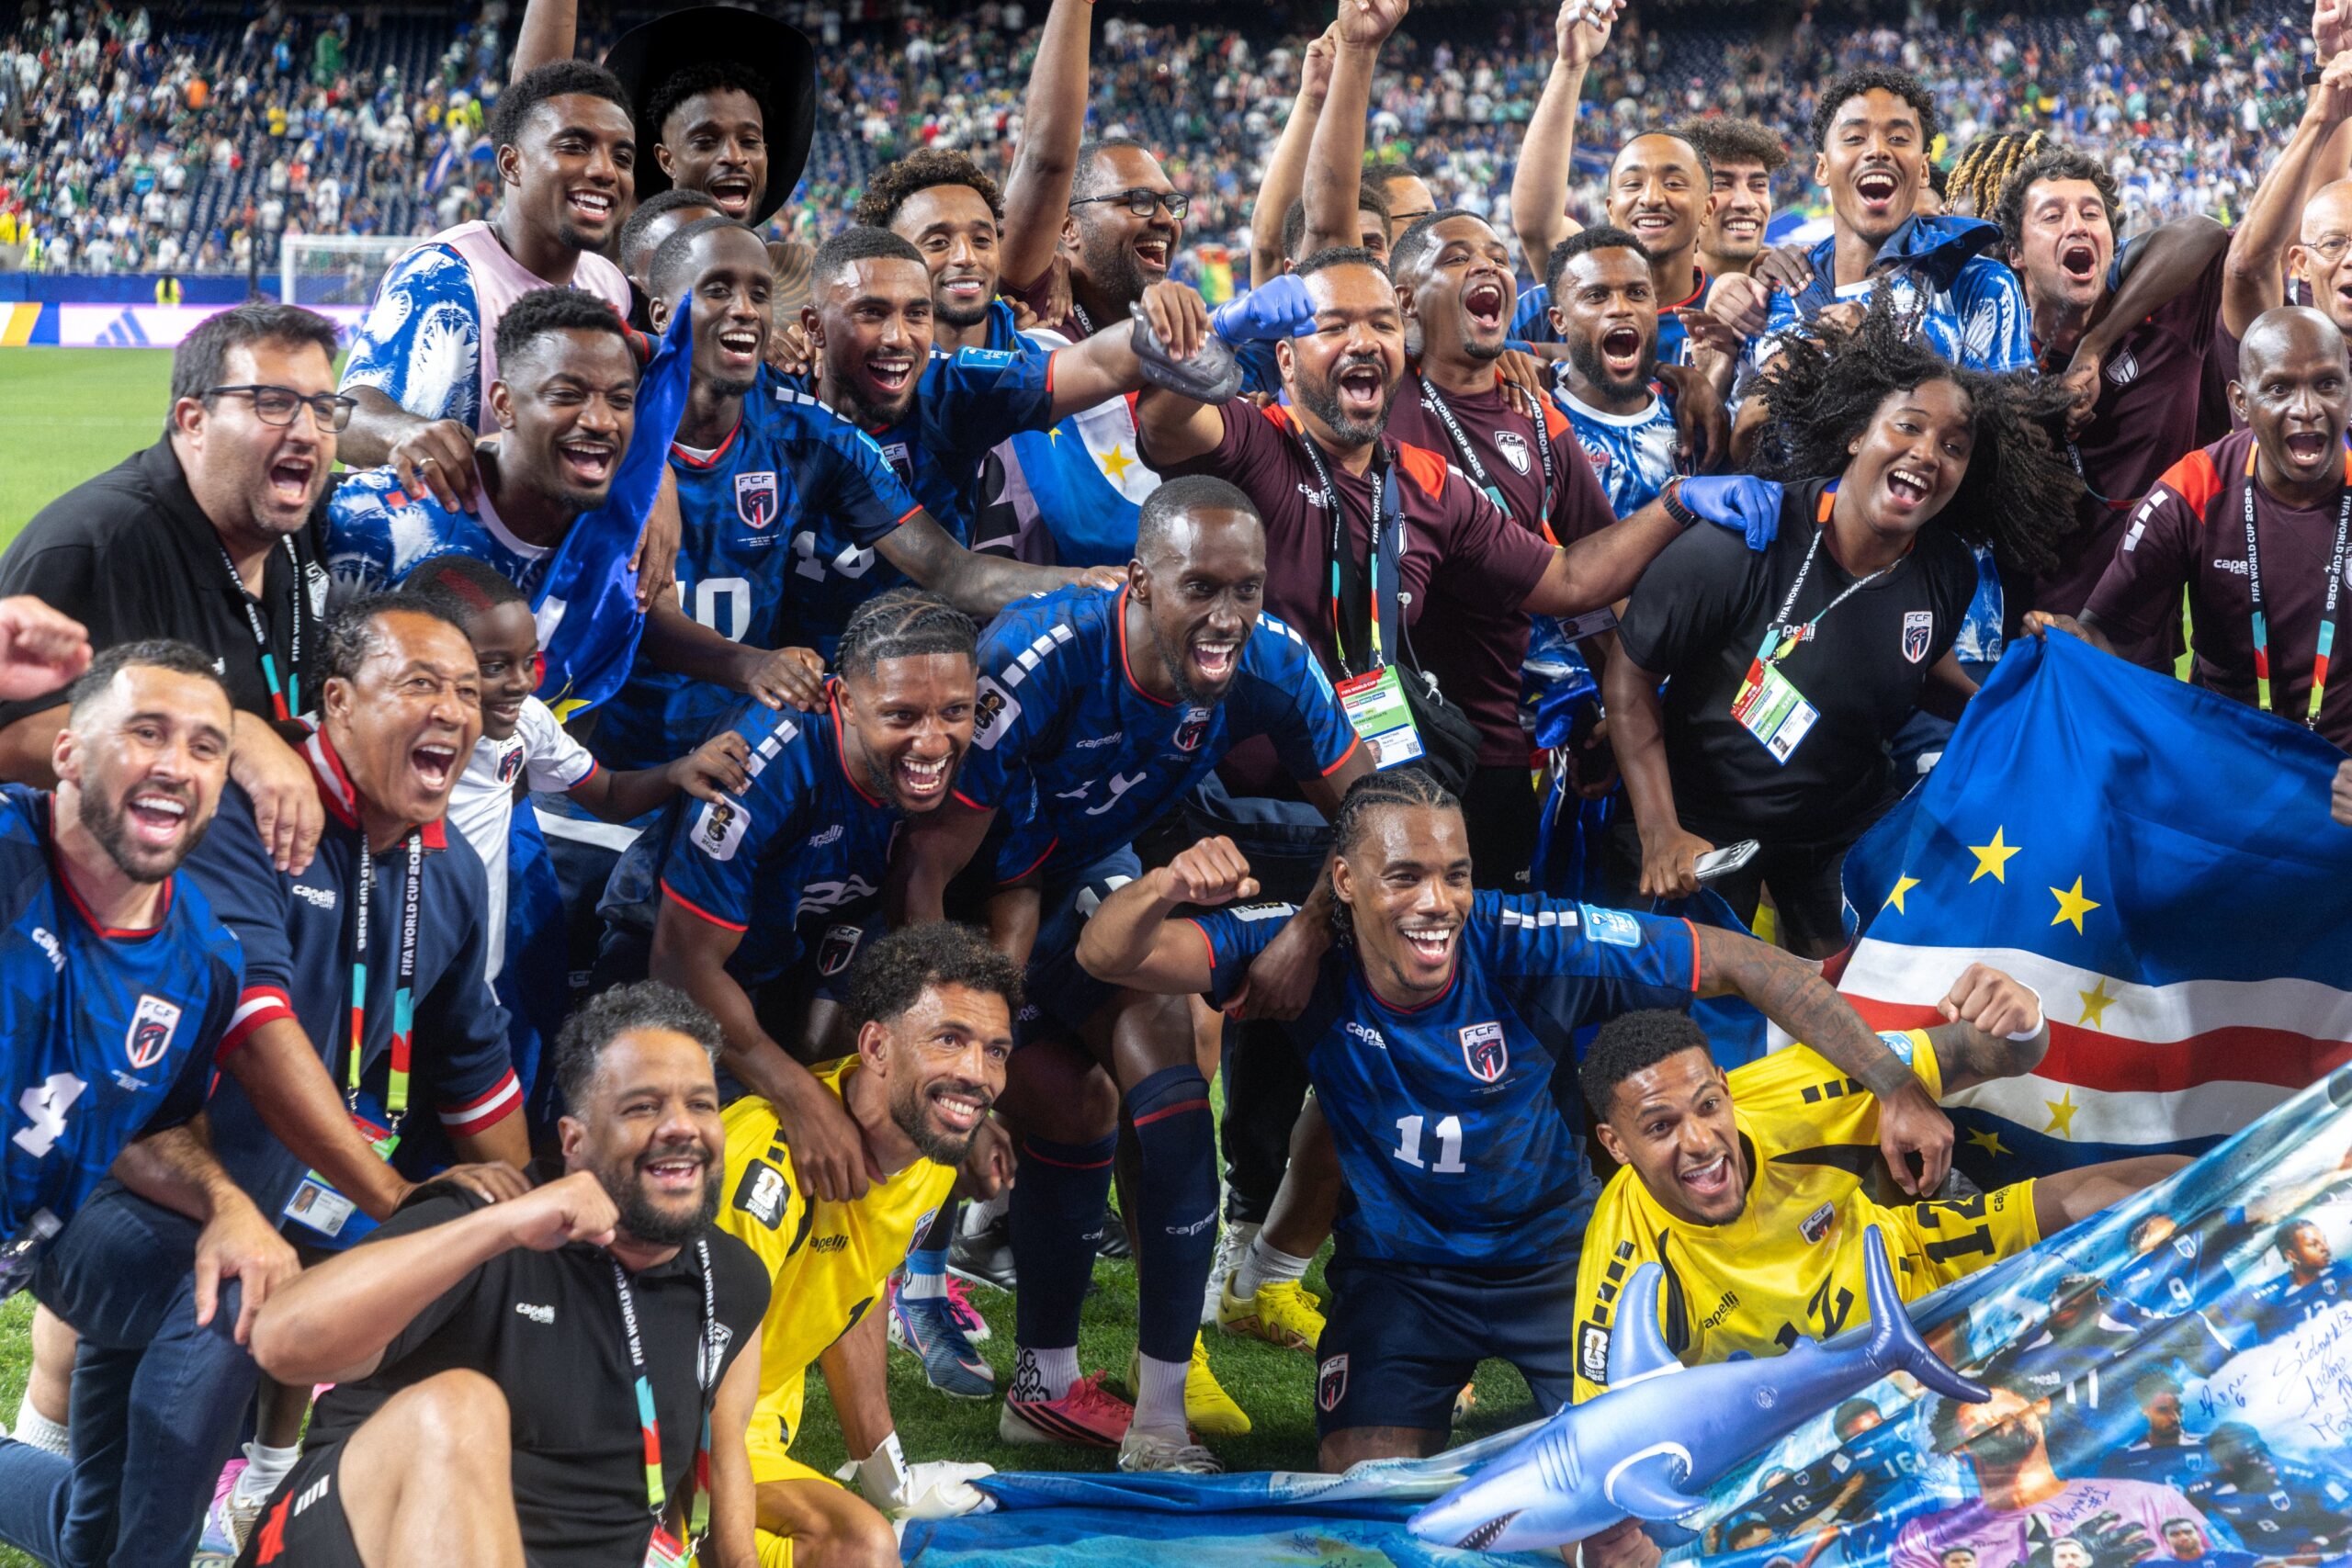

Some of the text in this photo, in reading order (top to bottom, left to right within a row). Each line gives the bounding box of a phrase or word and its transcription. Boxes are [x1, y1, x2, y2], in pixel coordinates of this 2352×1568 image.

[1074, 303, 1093, 333] 2026
[1422, 381, 1436, 400] FIFA
[1433, 397, 1456, 429] WORLD
[1453, 426, 1467, 447] CUP
[1464, 446, 1486, 480] 2026
[1498, 434, 1524, 445] FCF
[1537, 420, 1550, 457] WORLD
[883, 446, 904, 457] CF
[1544, 456, 1553, 477] FIFA
[739, 475, 773, 487] FCF
[2340, 495, 2352, 517] FIFA
[2245, 486, 2261, 603] FIFA WORLD CUP 2026
[2335, 518, 2348, 554] WORLD
[2213, 558, 2248, 573] cape
[2332, 555, 2343, 574] CUP
[1777, 606, 1792, 624] FIFA
[1786, 577, 1804, 606] WORLD
[1799, 560, 1812, 577] CUP
[2326, 575, 2340, 612] 2026
[1906, 614, 1931, 623] FCF
[292, 884, 337, 906] capelli
[359, 880, 368, 905] CUP
[401, 833, 423, 976] FIFA WORLD CUP 2026
[141, 999, 175, 1019] FCF
[1345, 1021, 1385, 1044] cape
[1464, 1024, 1499, 1041] FCF
[12, 1071, 89, 1159] 4
[1394, 1114, 1466, 1173] 11
[1801, 1202, 1832, 1232] FCF
[697, 1240, 711, 1269] FIFA
[704, 1269, 715, 1316] WORLD
[2168, 1277, 2193, 1308] 9
[515, 1302, 556, 1321] capelli
[618, 1289, 639, 1336] WORLD
[1703, 1291, 1739, 1329] apelli
[628, 1335, 645, 1366] FIFA
